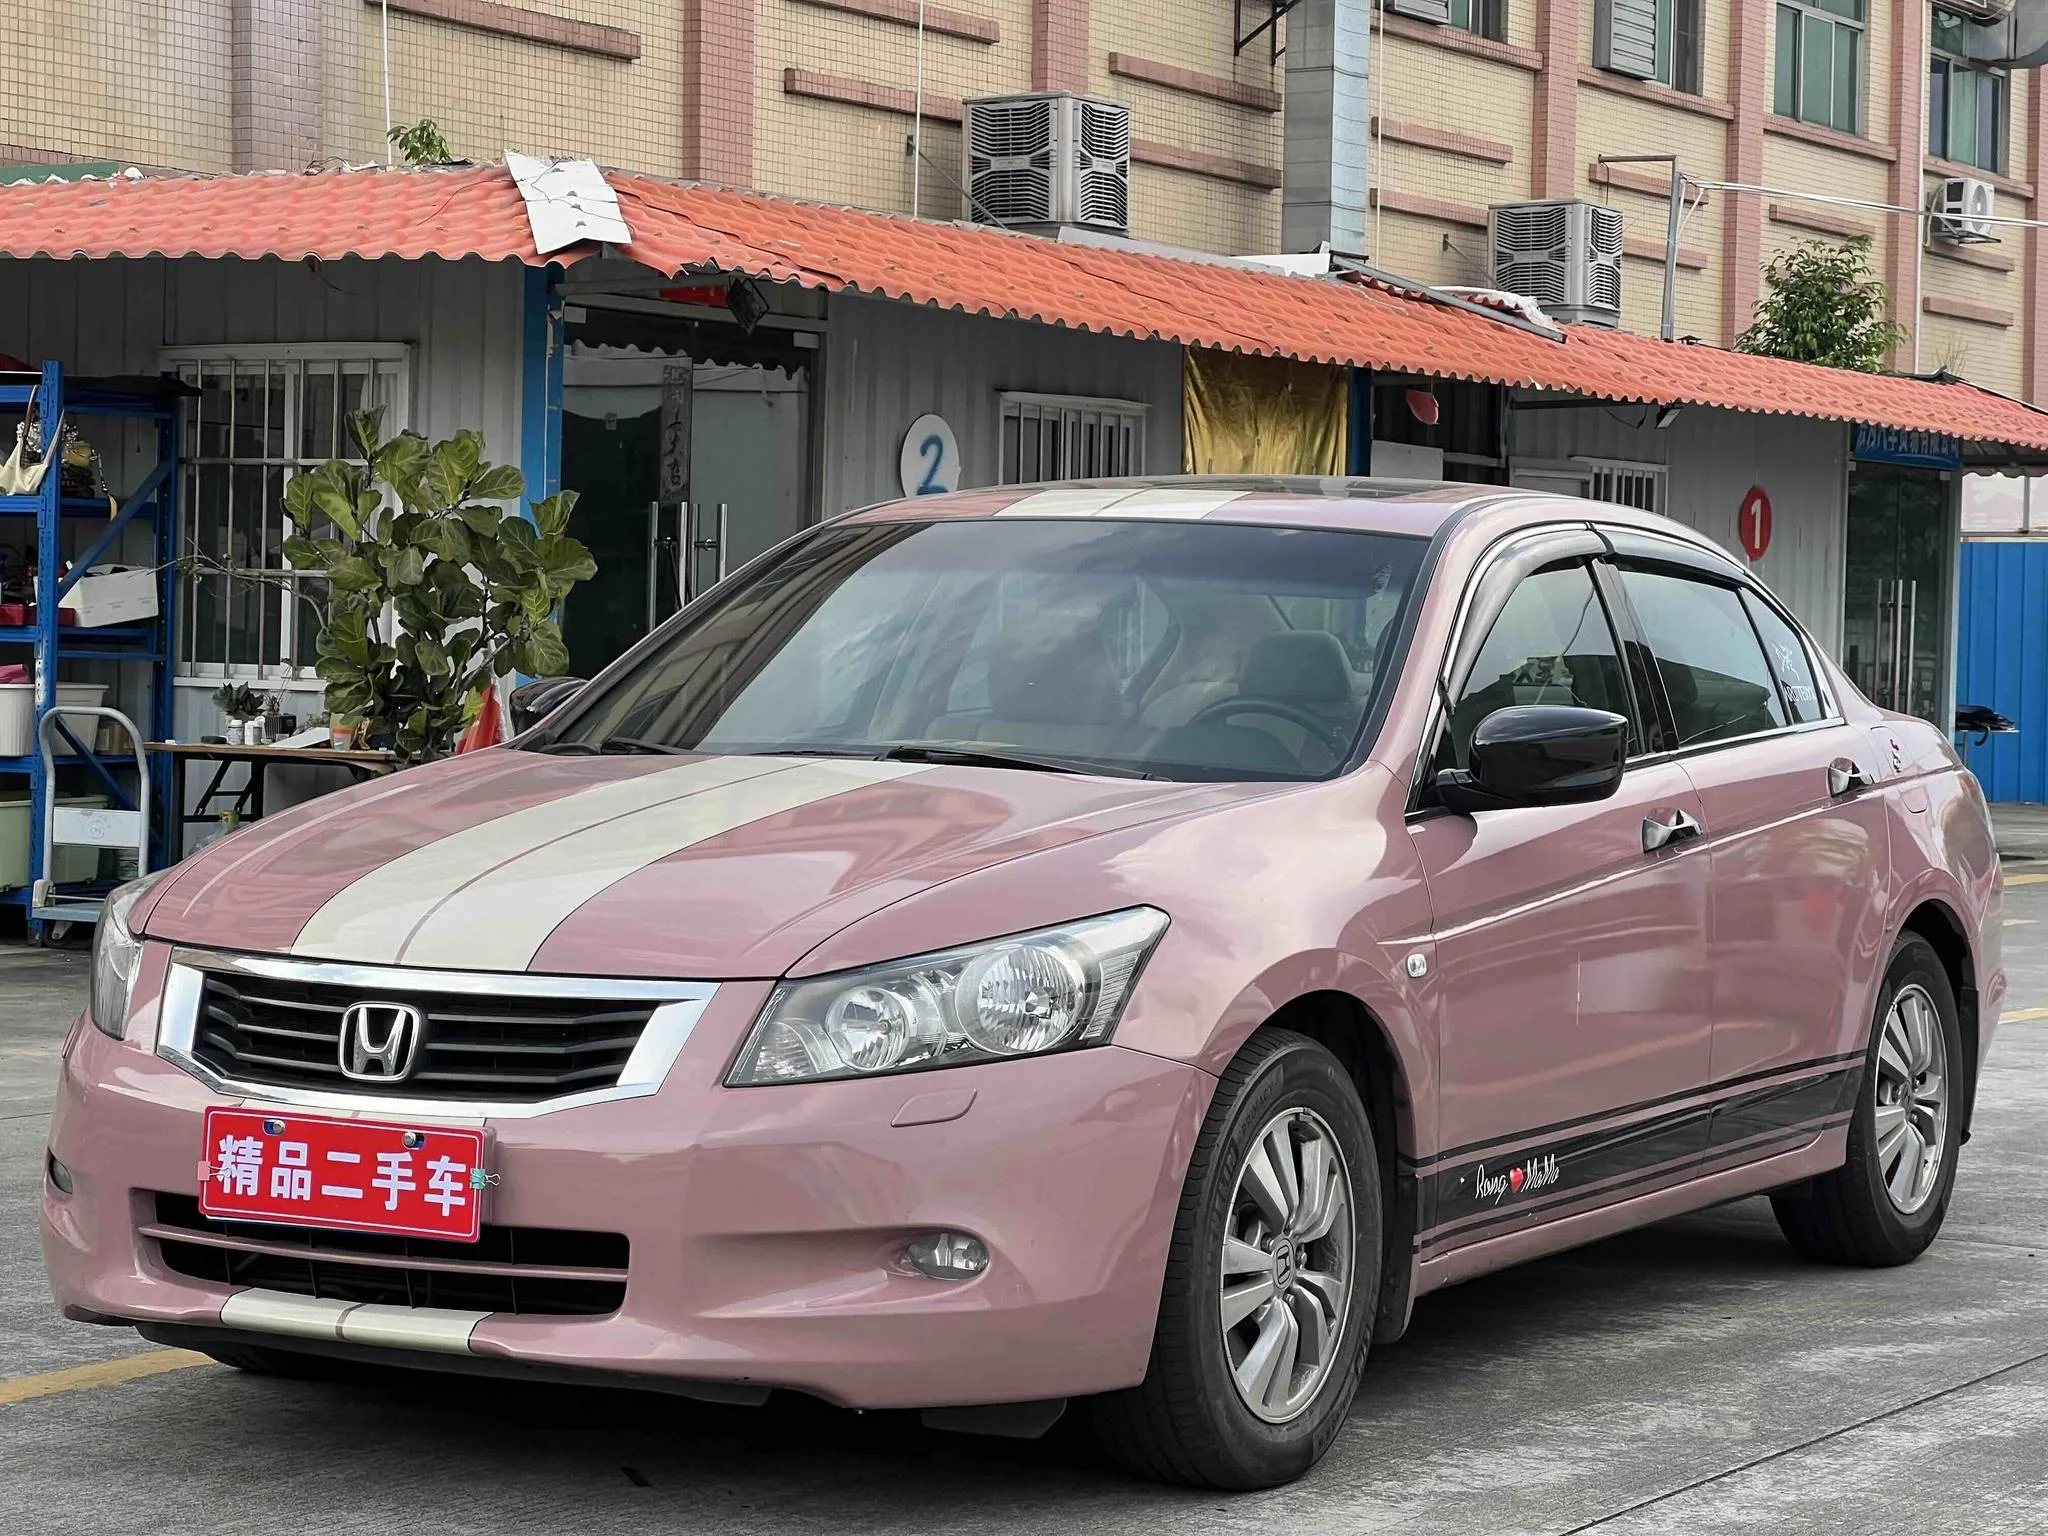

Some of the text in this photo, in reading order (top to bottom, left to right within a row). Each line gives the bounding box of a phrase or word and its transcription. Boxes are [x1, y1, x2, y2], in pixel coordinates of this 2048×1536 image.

[916, 434, 948, 495] 2
[1751, 498, 1762, 549] 1
[216, 1134, 467, 1217] 精品二手车
